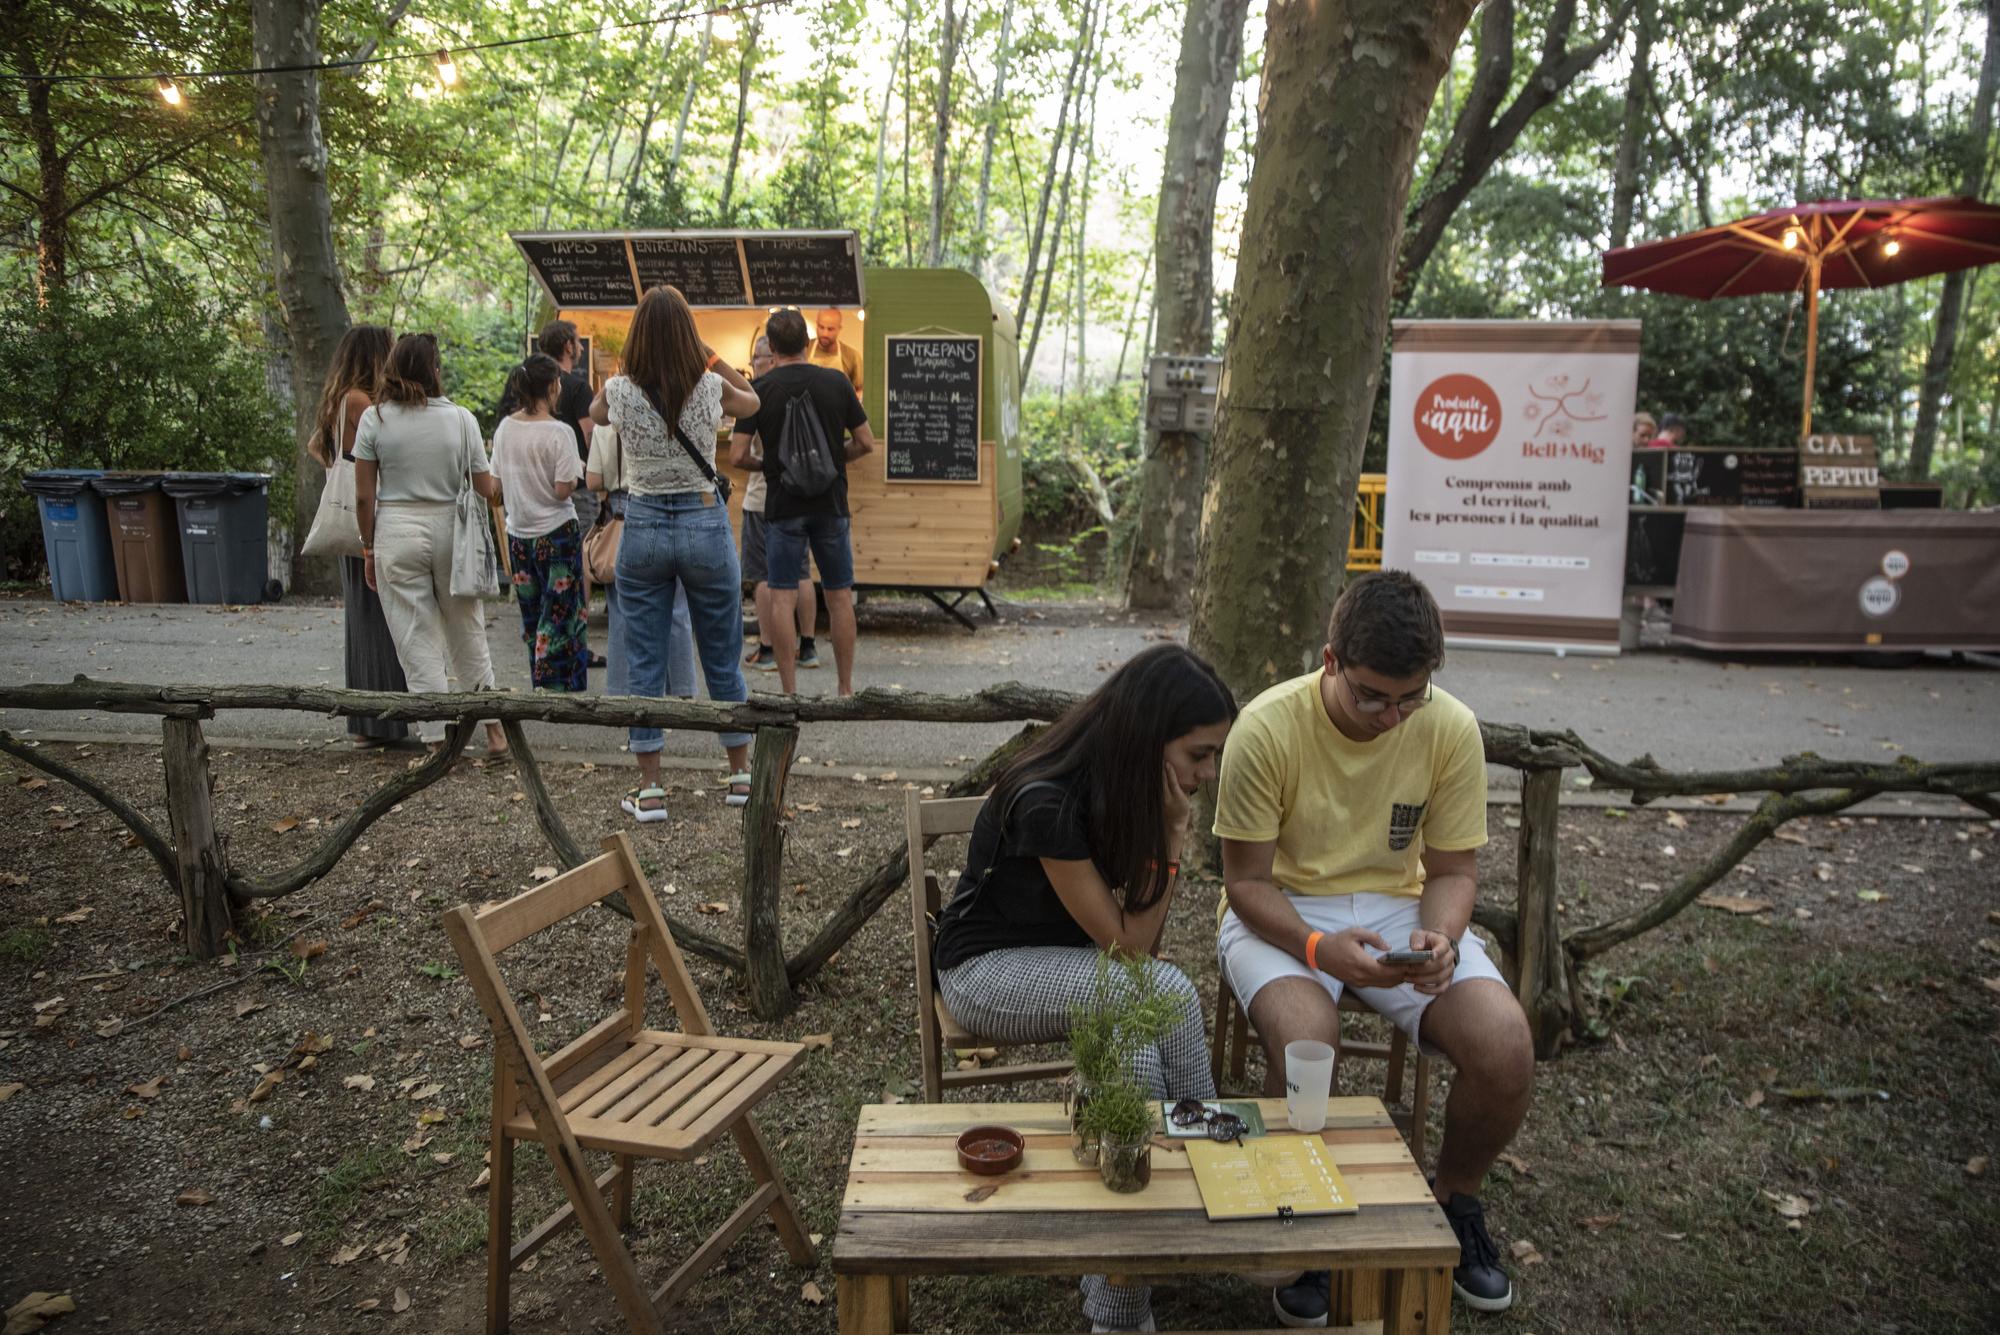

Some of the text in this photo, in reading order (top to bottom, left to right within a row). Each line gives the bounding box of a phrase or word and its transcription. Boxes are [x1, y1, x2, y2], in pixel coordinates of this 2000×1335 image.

[551, 239, 597, 254] TAPES
[635, 239, 708, 254] ENTREPANS
[896, 342, 976, 363] ENTREPANS
[1523, 442, 1605, 464] Bell+Mig
[1807, 434, 1862, 454] CAL
[1538, 479, 1571, 491] amb
[1803, 466, 1879, 487] PEPITU
[1462, 494, 1476, 506] el
[1409, 509, 1431, 522] les
[1436, 512, 1505, 525] persones
[1520, 513, 1535, 526] la
[1539, 514, 1600, 529] qualitat
